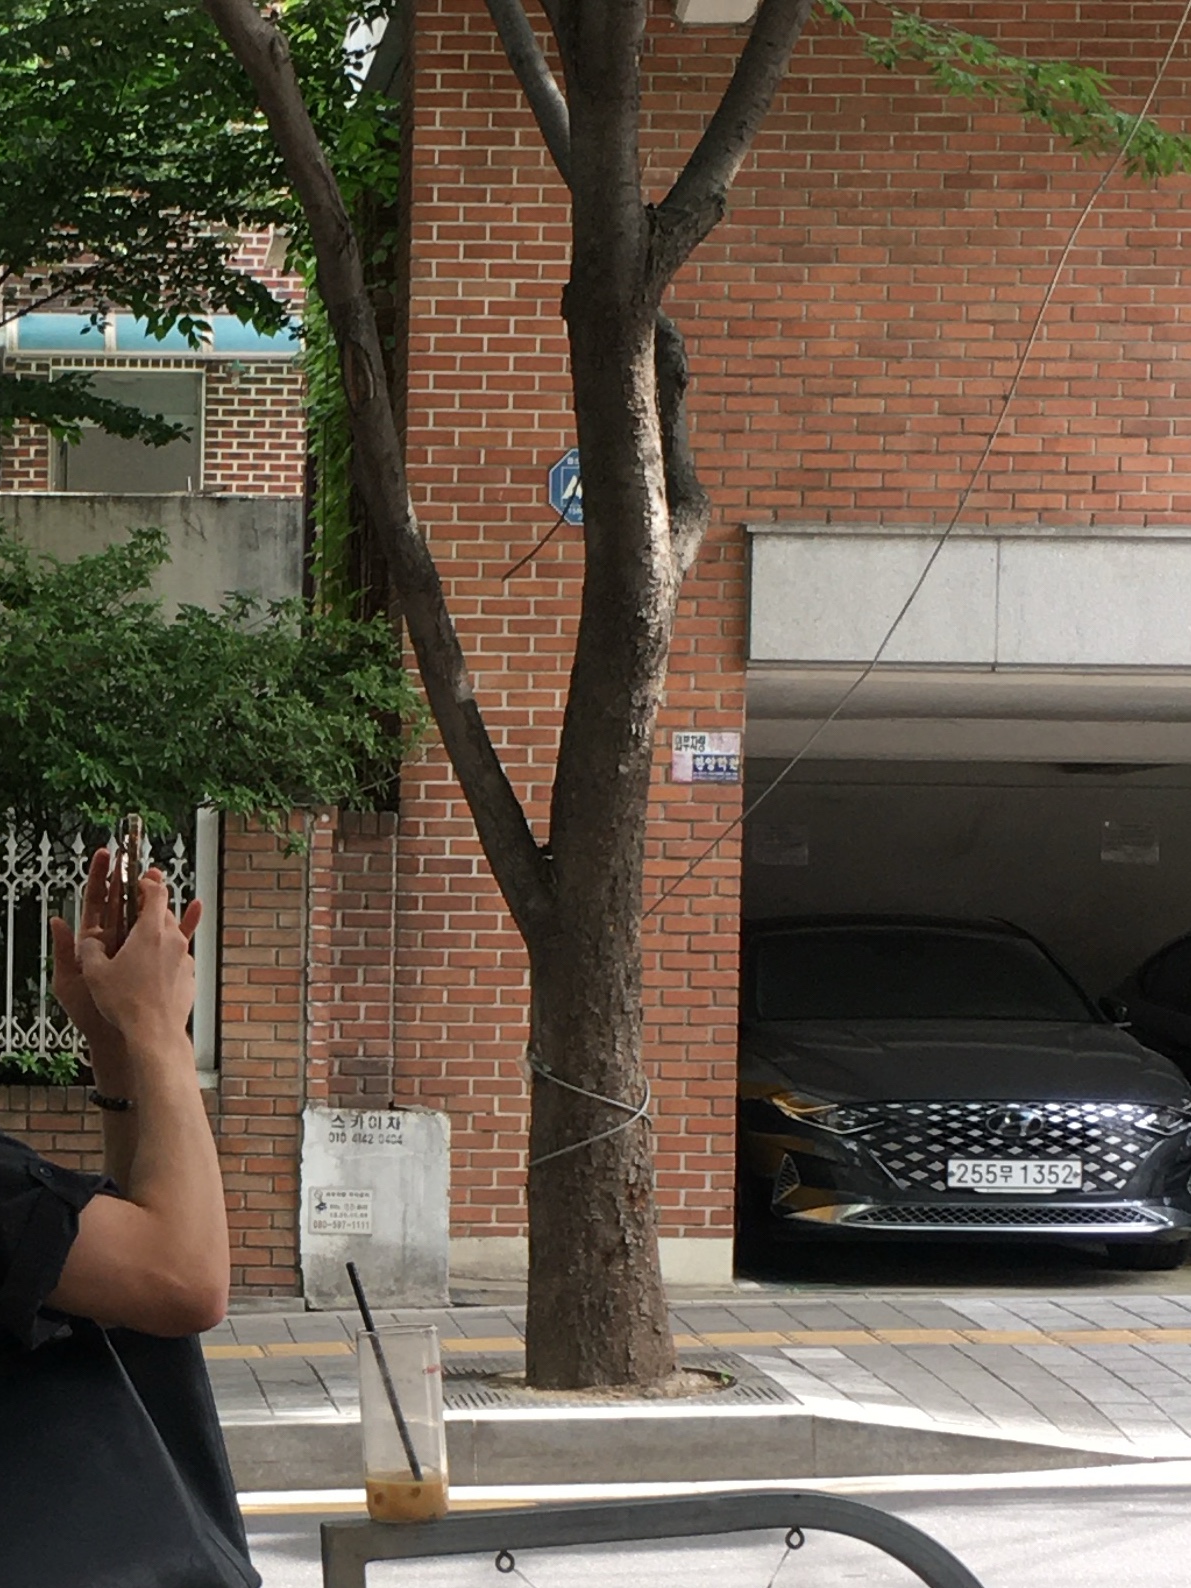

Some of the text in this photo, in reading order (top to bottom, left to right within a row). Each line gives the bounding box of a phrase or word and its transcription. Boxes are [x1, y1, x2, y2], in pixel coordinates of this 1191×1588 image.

[328, 1132, 347, 1144] 010
[956, 1163, 1074, 1184] 255무 1352
